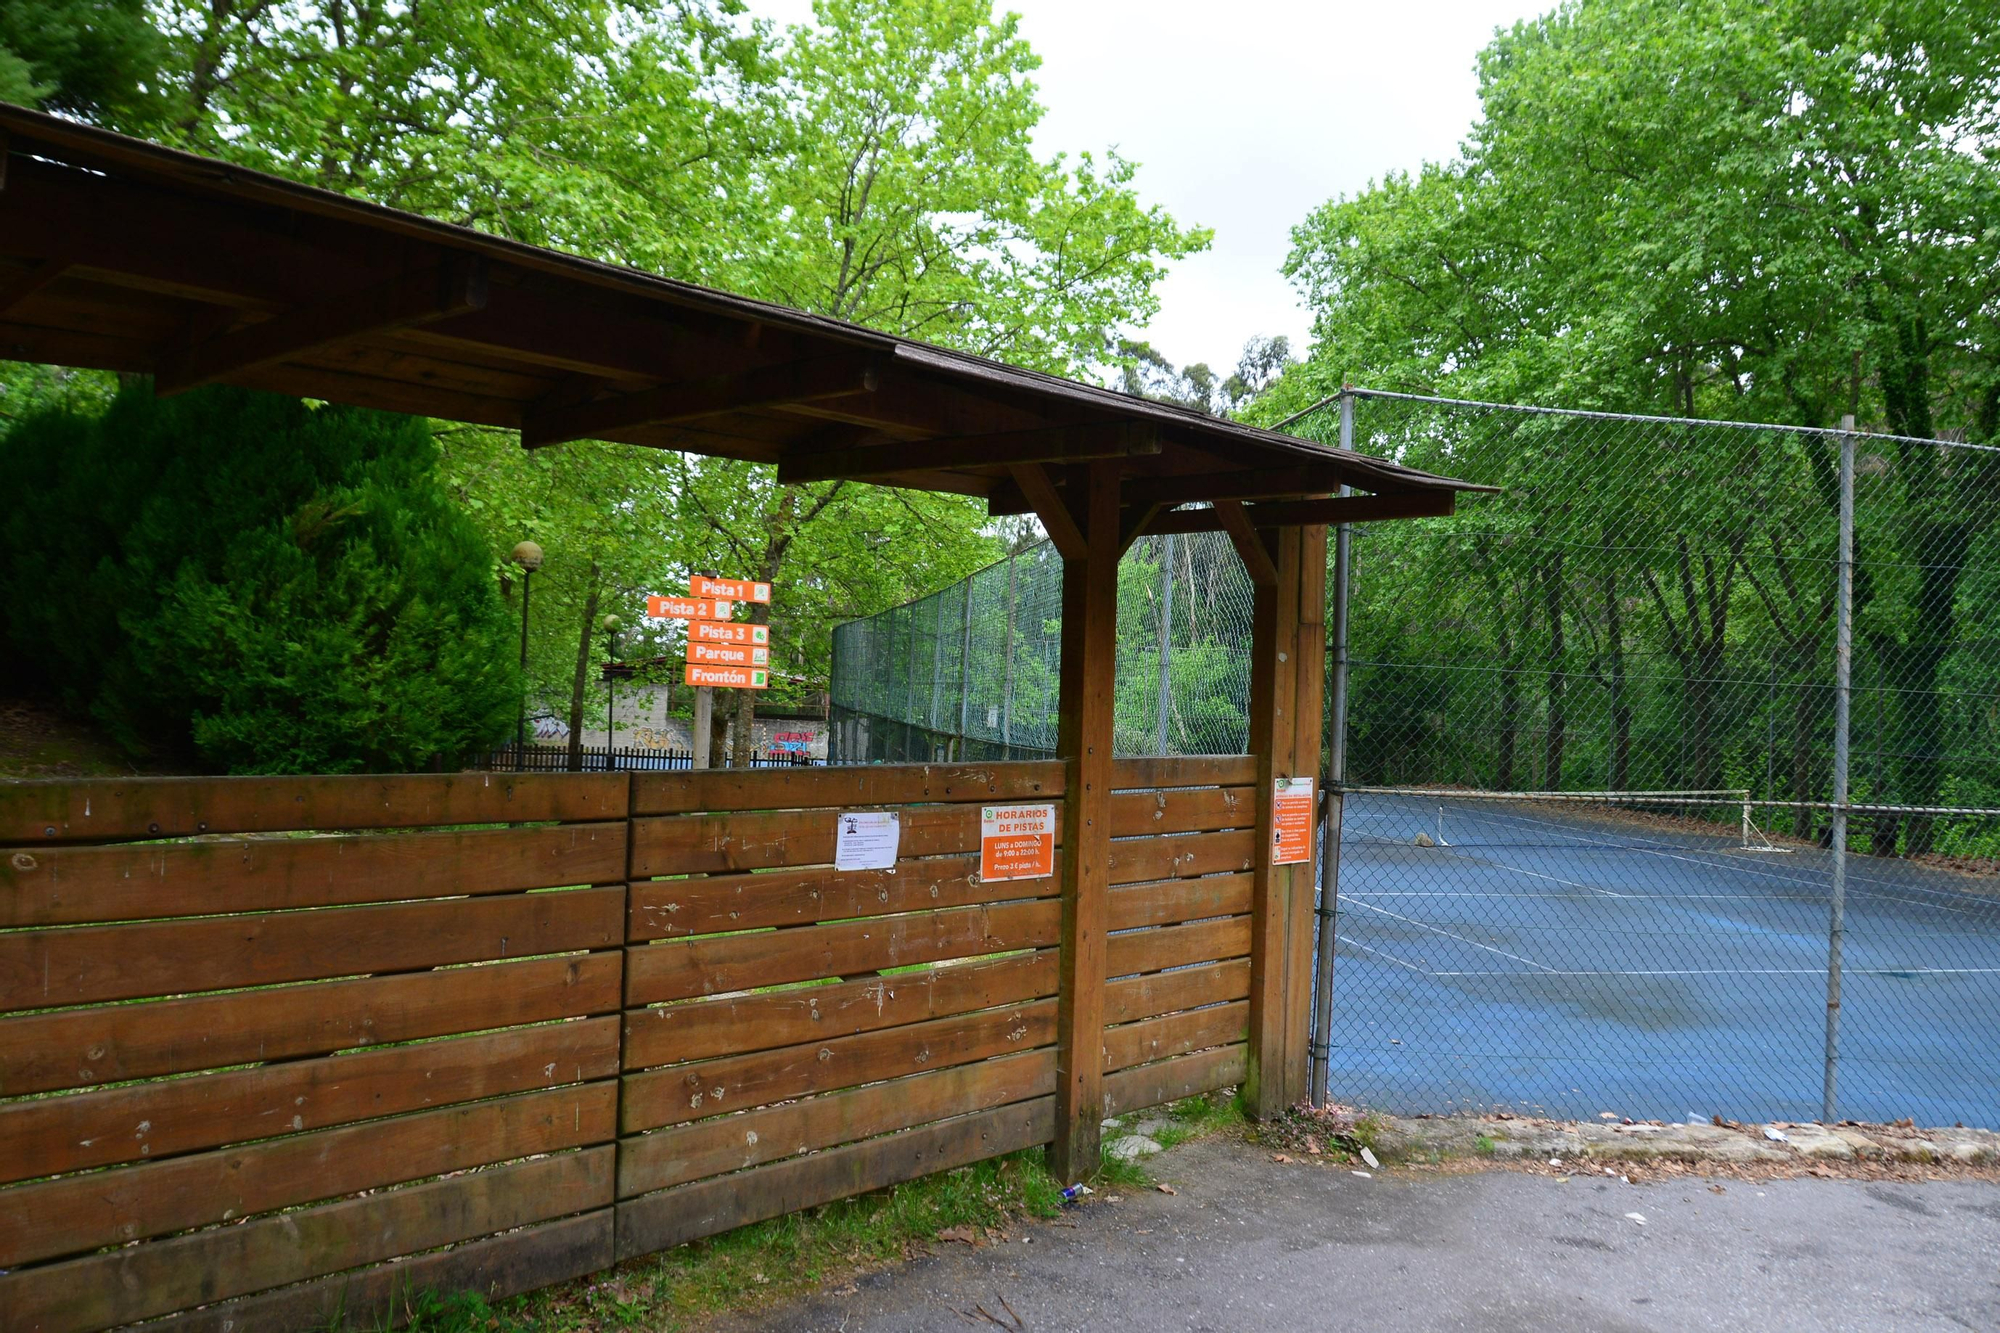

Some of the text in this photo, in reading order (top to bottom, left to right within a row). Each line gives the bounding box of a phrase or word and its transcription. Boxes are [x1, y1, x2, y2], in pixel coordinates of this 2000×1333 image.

[702, 580, 744, 597] Pista 1
[660, 600, 707, 616] Pista 2
[699, 624, 745, 640] Pista 3
[696, 646, 744, 662] Parque
[692, 668, 746, 684] Frontón
[996, 810, 1048, 820] HORARIOS
[998, 822, 1044, 832] DE PISTAS
[994, 841, 1010, 850] LUNS
